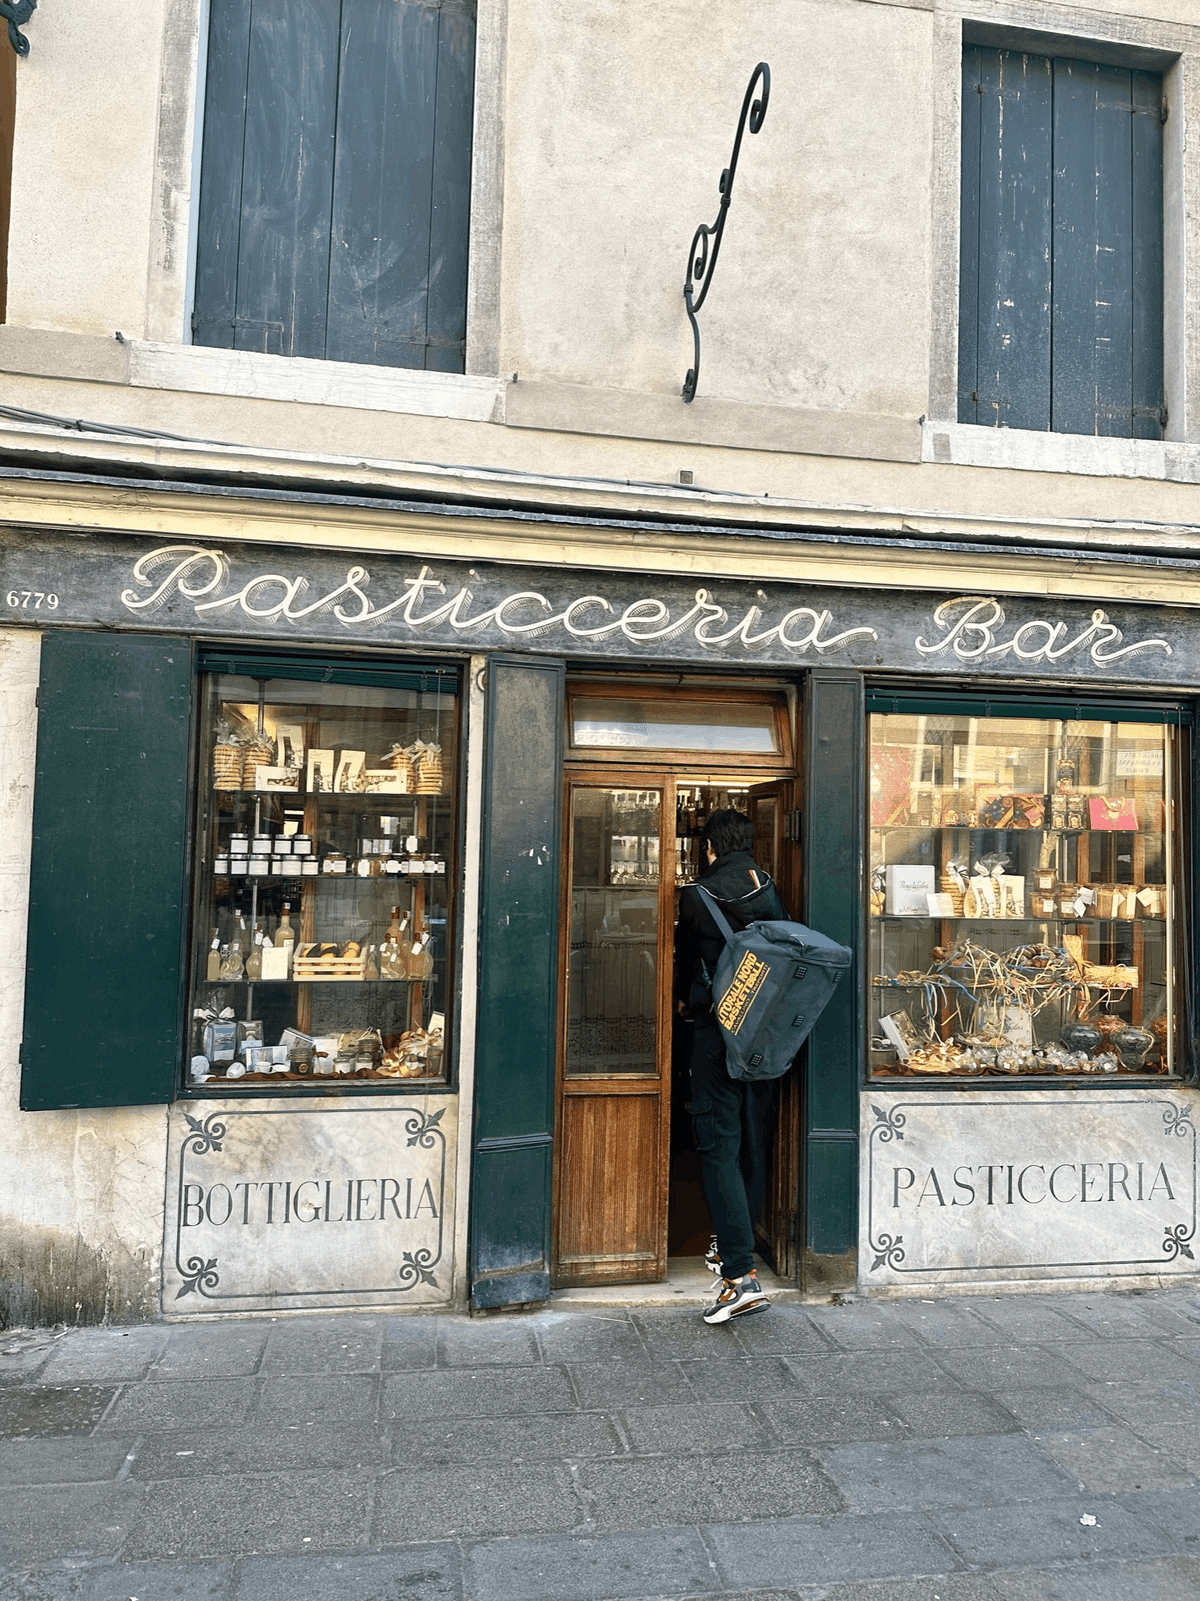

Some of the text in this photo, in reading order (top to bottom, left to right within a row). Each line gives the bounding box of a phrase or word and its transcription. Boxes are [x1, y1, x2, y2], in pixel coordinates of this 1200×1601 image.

[6, 590, 59, 610] 6779
[121, 545, 1173, 666] Pasticceria Bar
[719, 952, 757, 1025] LITORALE NORD
[723, 961, 765, 1031] BASKETBALL
[182, 1177, 438, 1227] BOTTIGLIERIA
[892, 1162, 1175, 1208] PASTICCERIA
